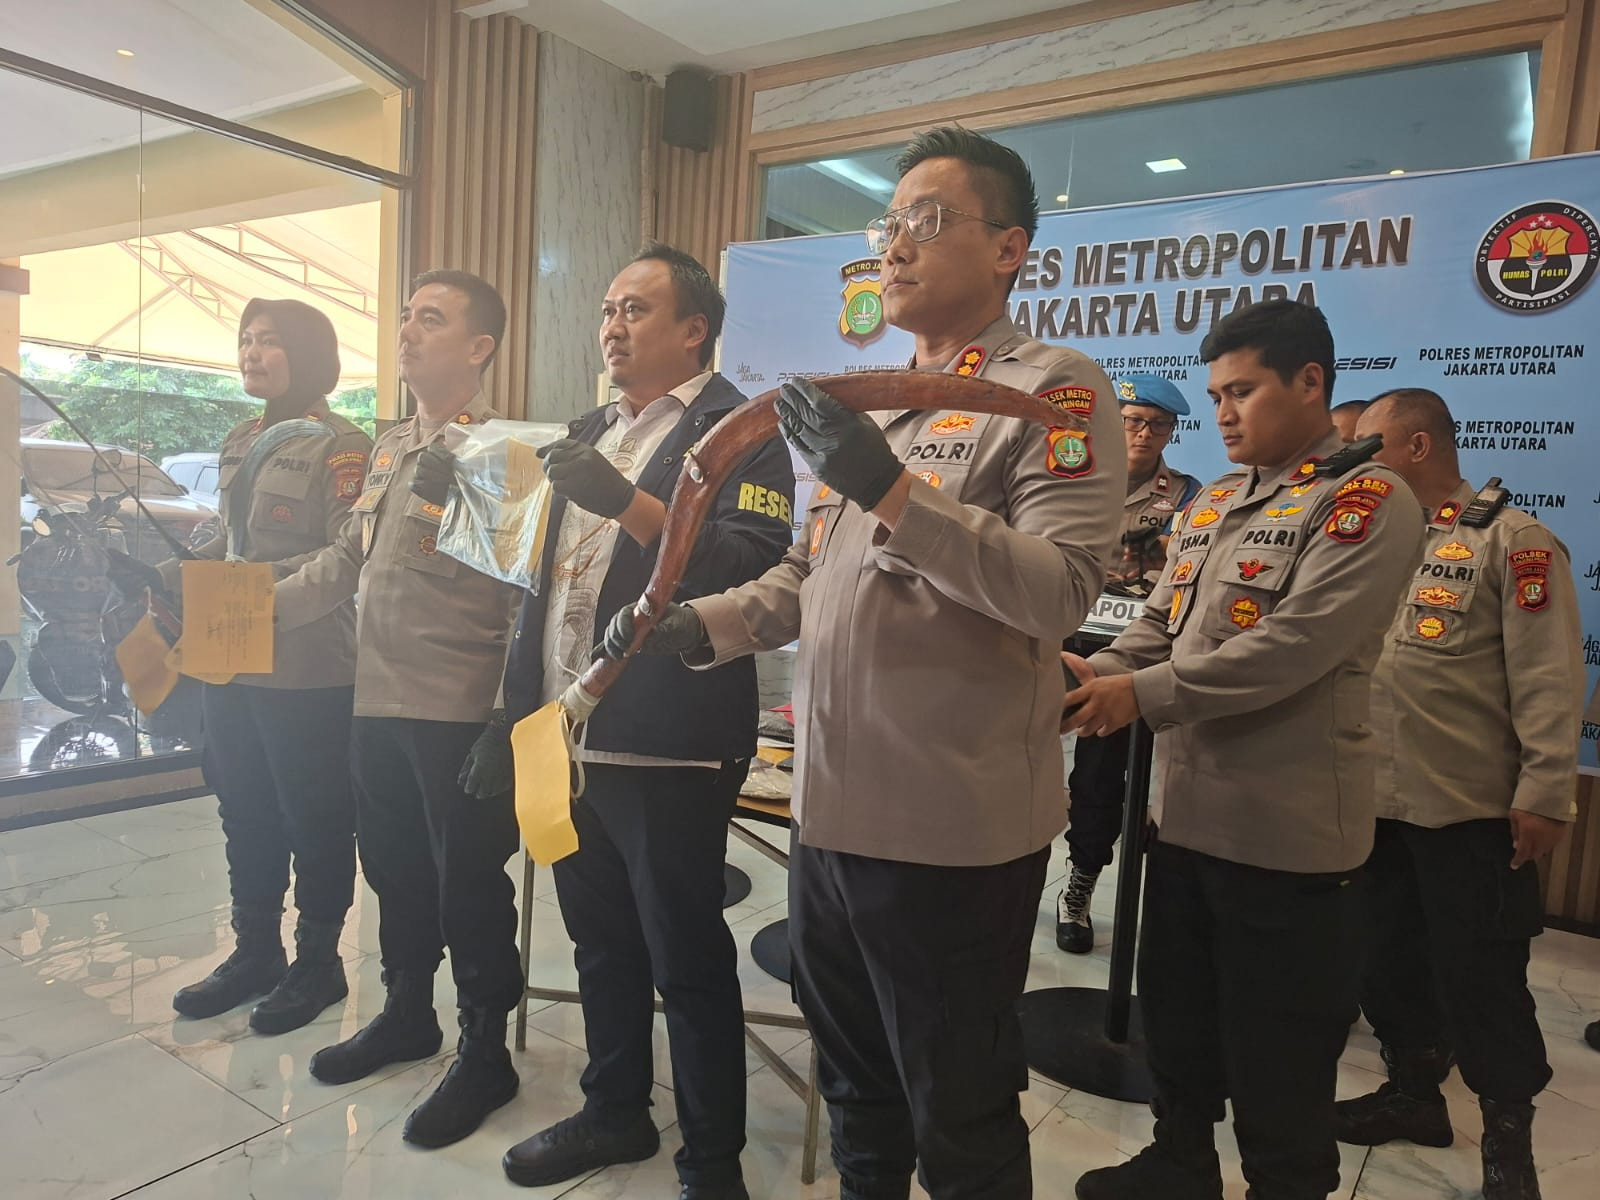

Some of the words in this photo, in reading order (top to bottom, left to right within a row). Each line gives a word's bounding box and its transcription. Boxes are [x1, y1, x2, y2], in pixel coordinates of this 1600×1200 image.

[1479, 213, 1518, 262] OBYEKTIF
[1562, 207, 1598, 260] DIPERCAYA
[1073, 216, 1412, 286] METROPOLITAN
[845, 262, 871, 276] METRO
[1502, 270, 1530, 279] HUMAS
[1540, 268, 1568, 278] POLRI
[1495, 290, 1571, 309] PARTISIPASI
[1419, 347, 1470, 361] POLRES
[1474, 344, 1585, 360] METROPOLITAN
[1094, 357, 1125, 369] OLRES
[1334, 356, 1398, 370] ESISI
[1443, 362, 1506, 376] JAKARTA
[1509, 361, 1556, 375] UTARA
[1066, 388, 1092, 401] METRO
[1056, 399, 1090, 410] ARINGAN
[1465, 421, 1575, 435] METROPOLITAN
[1501, 437, 1547, 451] UTARA
[905, 442, 974, 462] POLRI
[737, 481, 793, 529] RESE
[1504, 492, 1566, 508] POLITAN
[1139, 515, 1164, 528] POL
[1242, 529, 1297, 548] POLRI
[1420, 563, 1475, 582] POLRI
